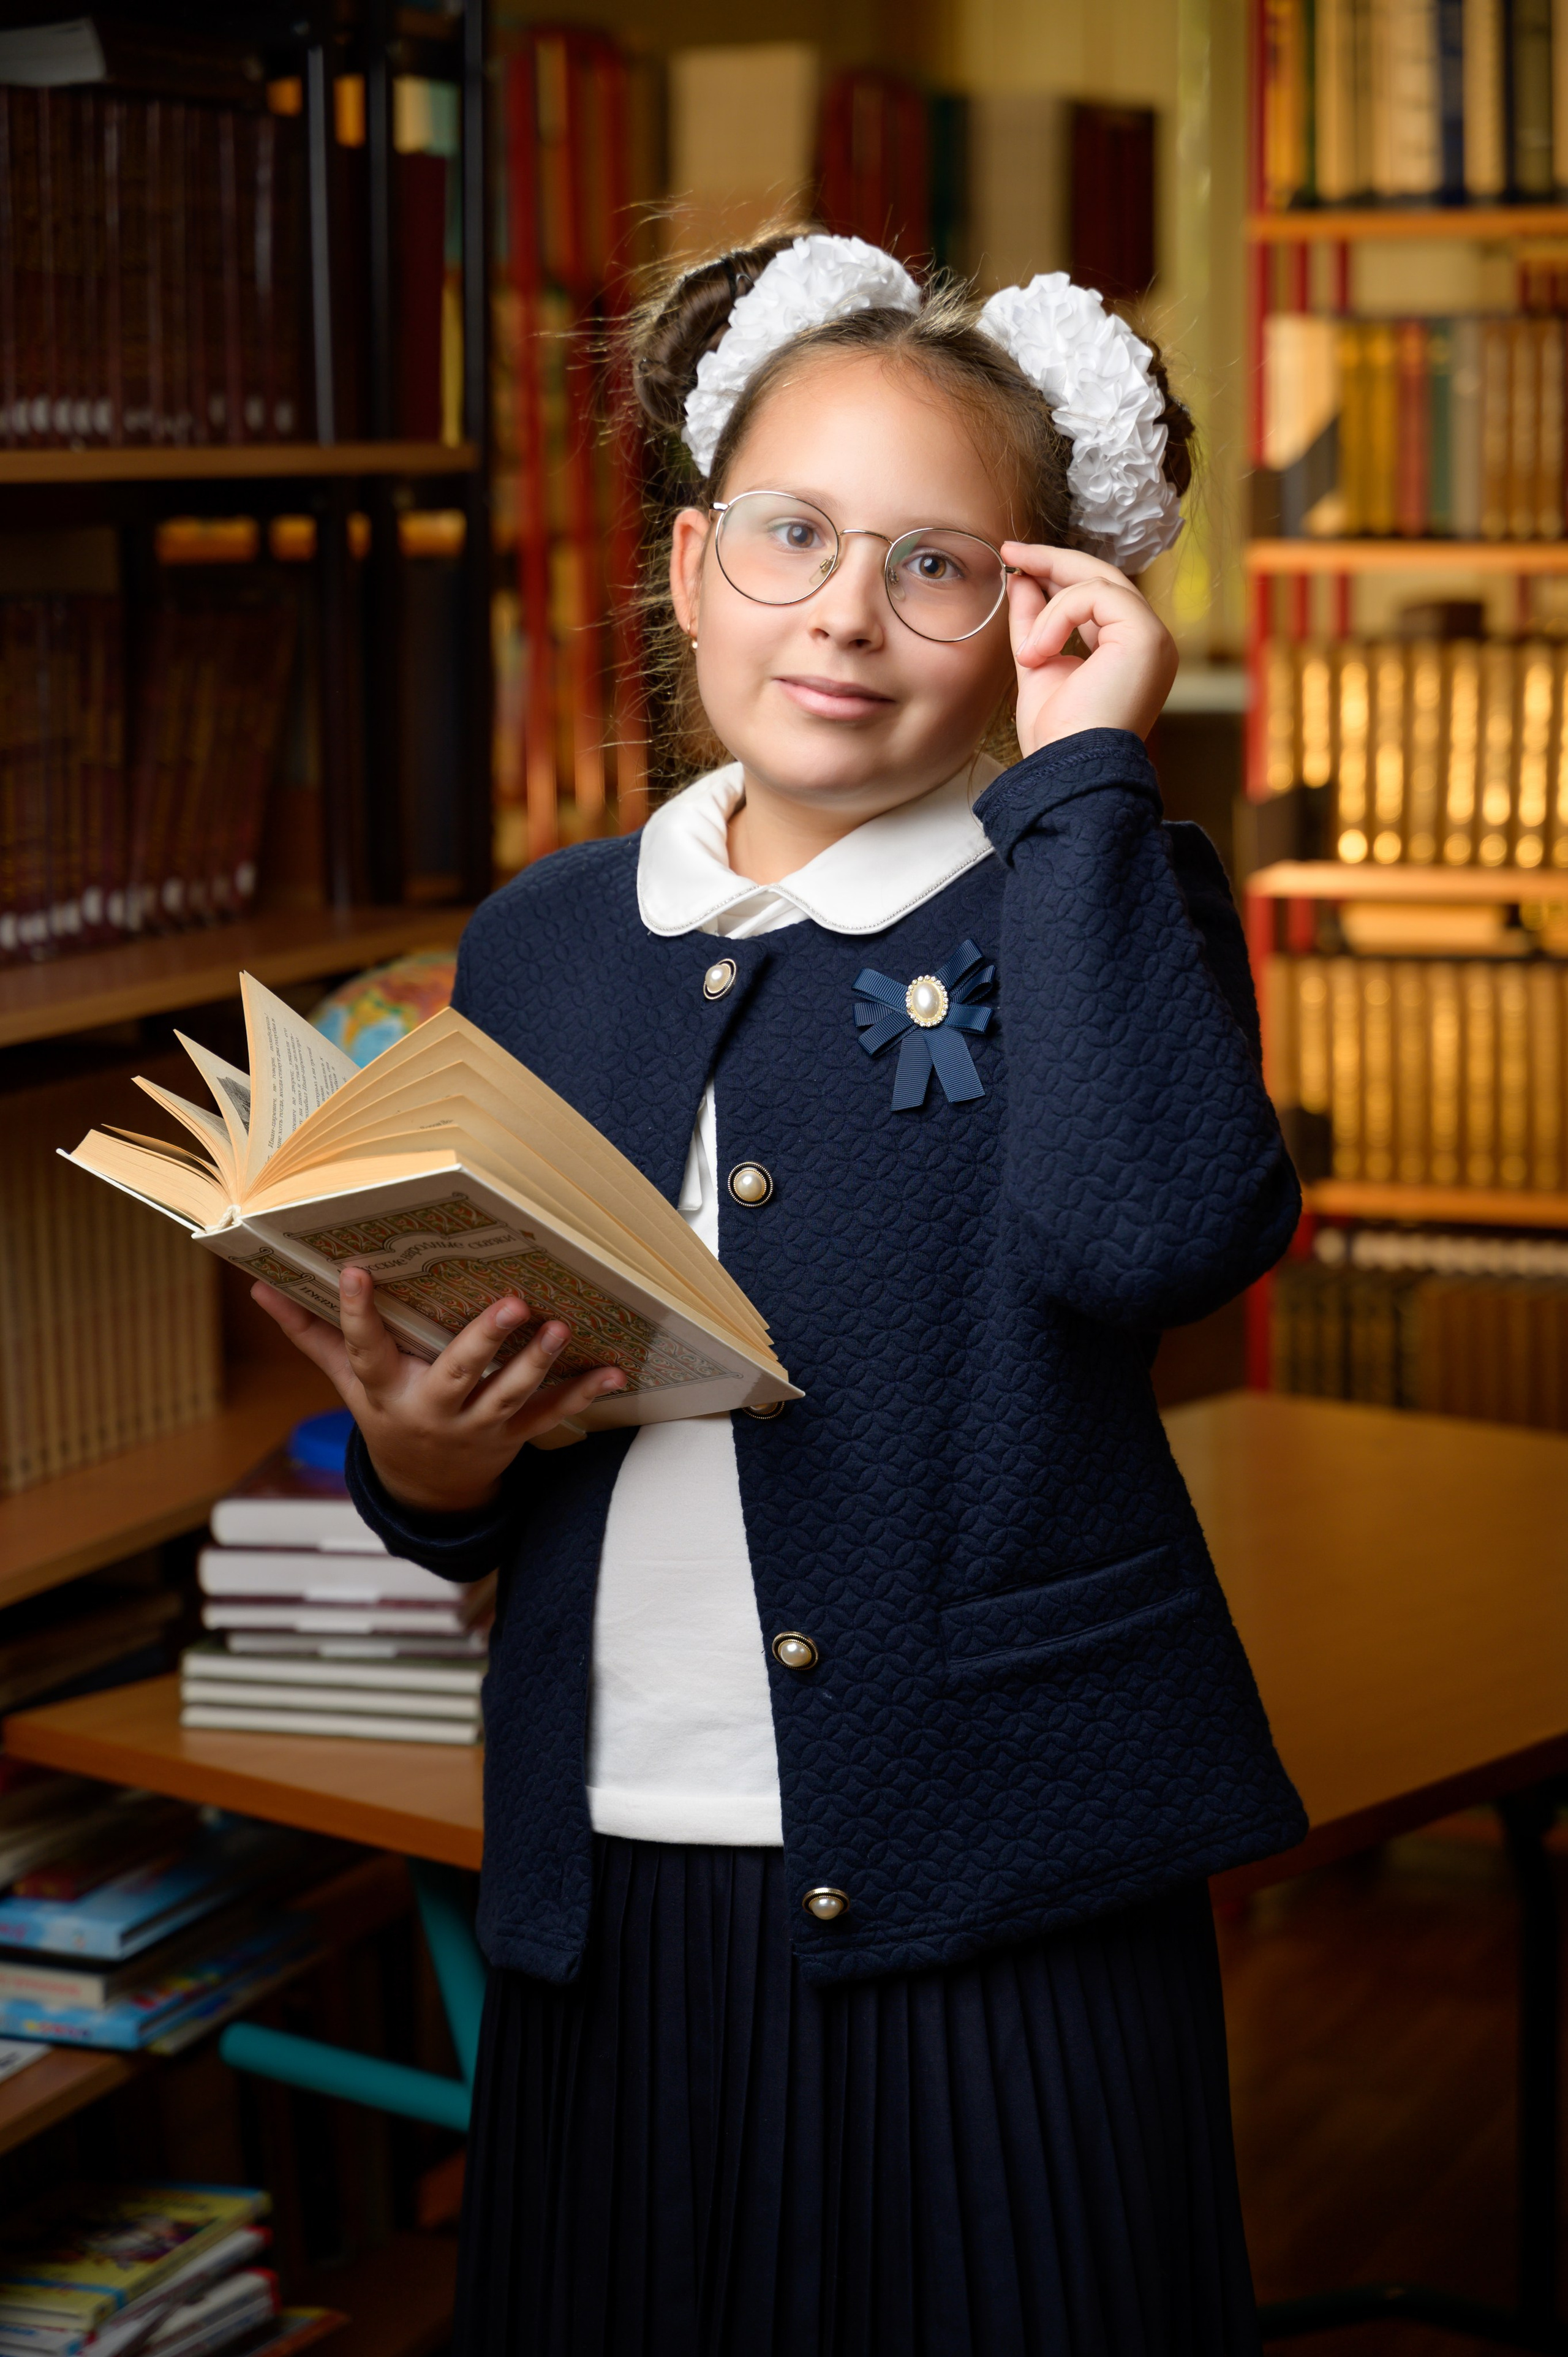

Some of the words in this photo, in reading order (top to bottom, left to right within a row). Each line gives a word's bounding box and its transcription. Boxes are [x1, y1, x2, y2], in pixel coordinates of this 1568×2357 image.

[355, 1258, 408, 1275] усские
[400, 1241, 466, 1261] народные
[467, 1234, 518, 1250] сказки
